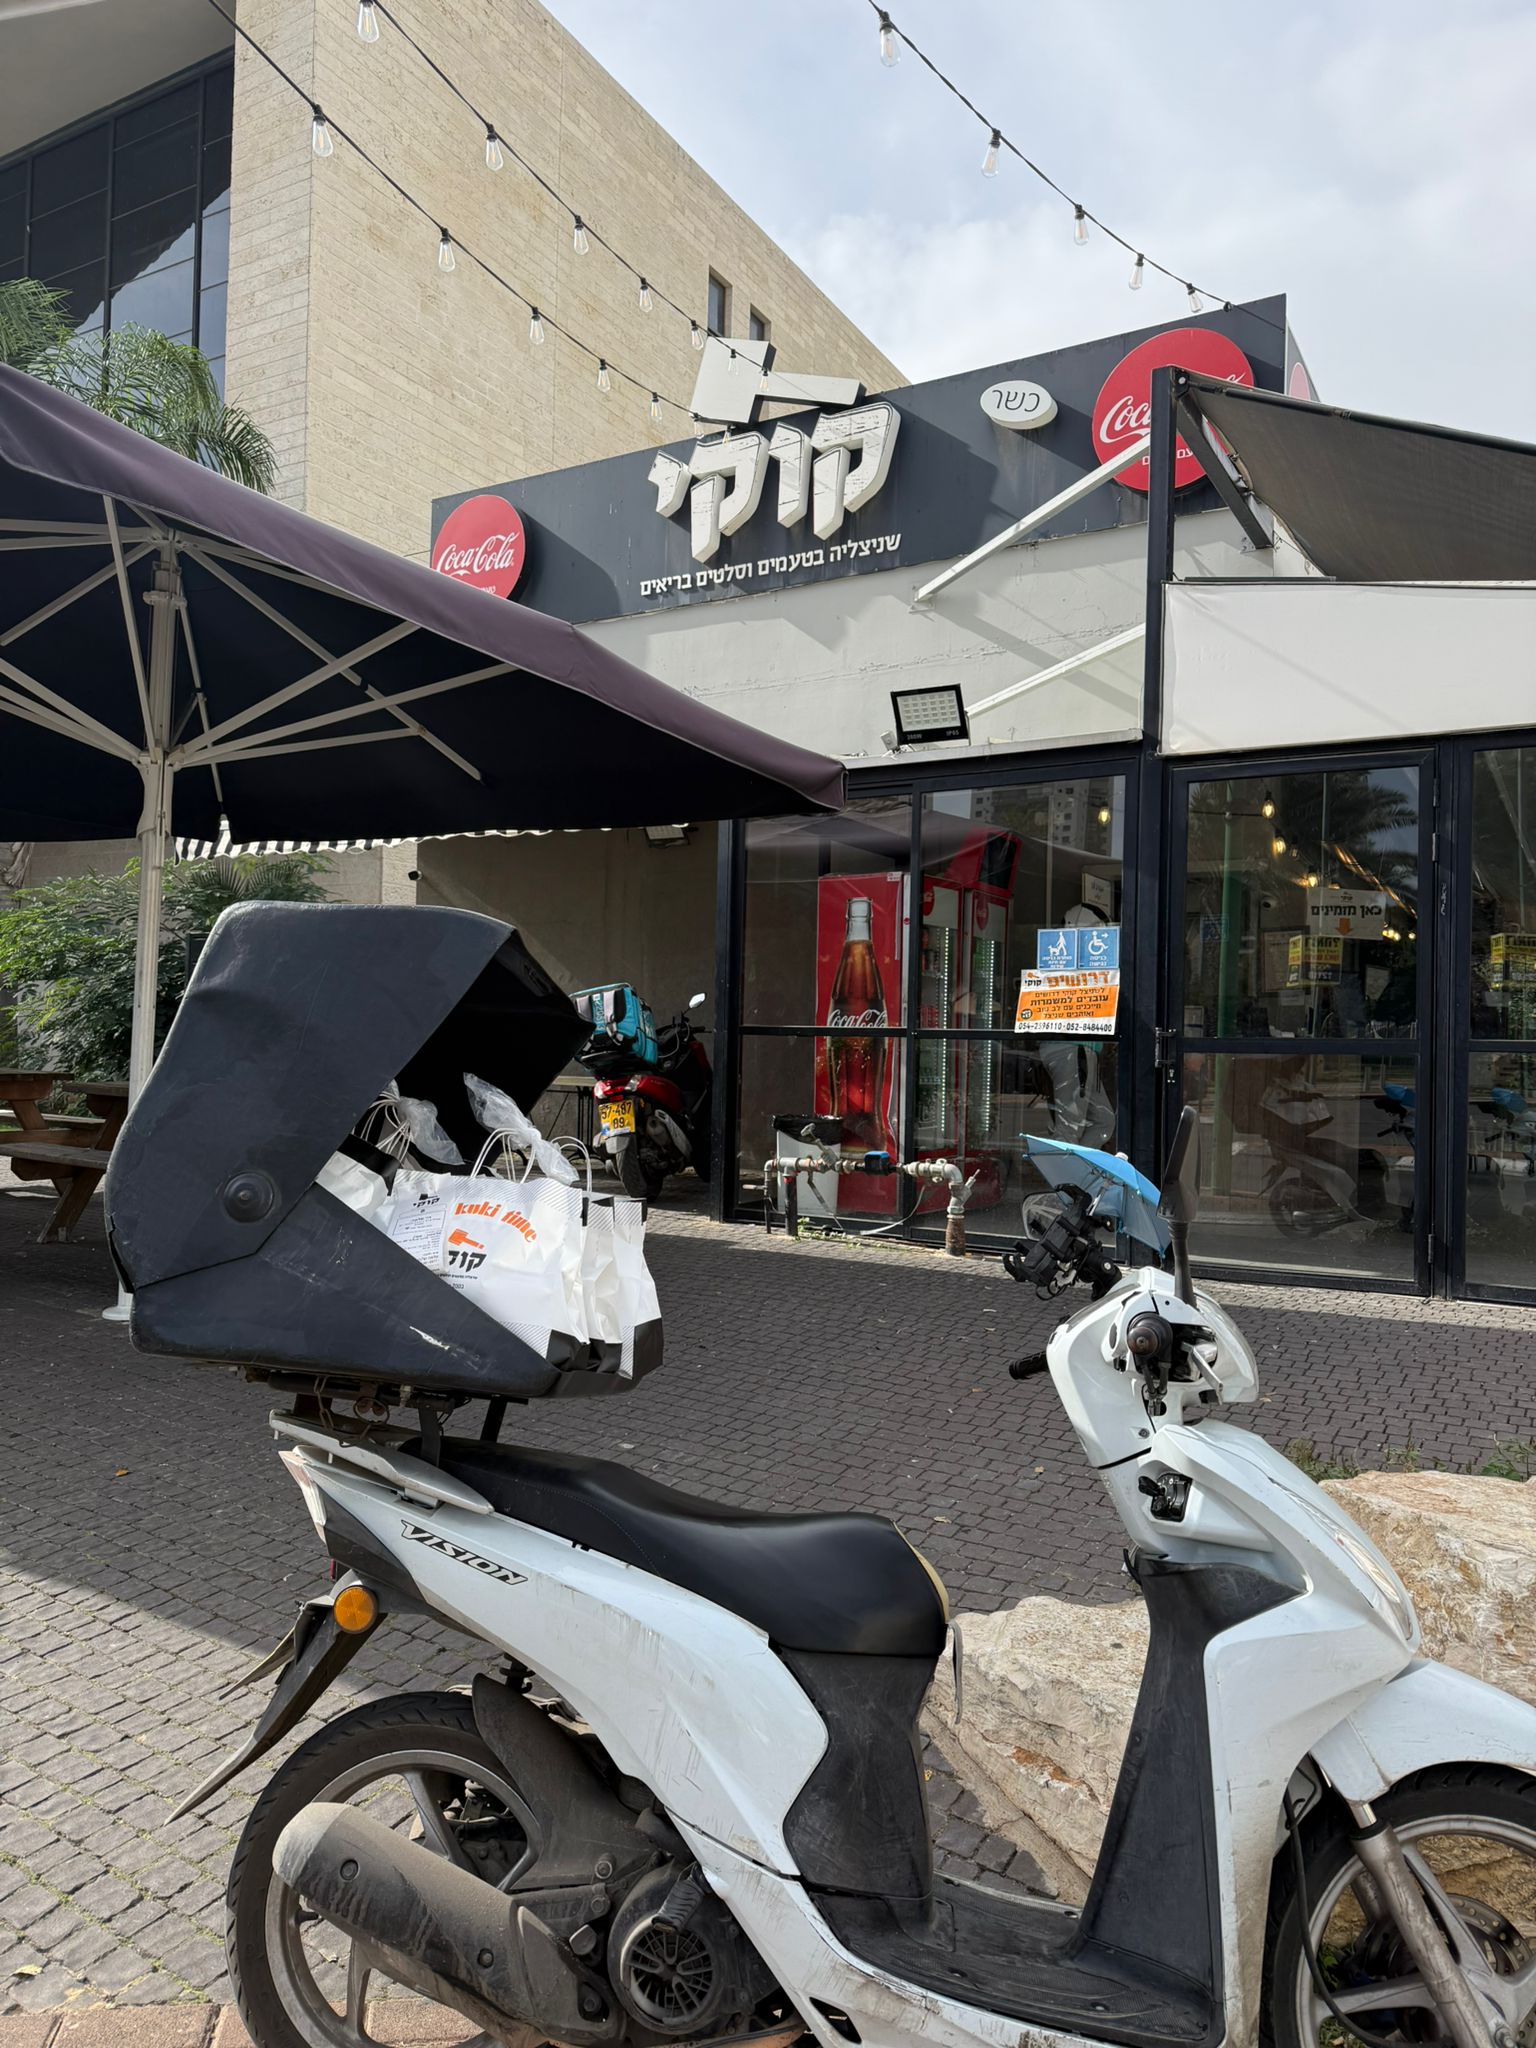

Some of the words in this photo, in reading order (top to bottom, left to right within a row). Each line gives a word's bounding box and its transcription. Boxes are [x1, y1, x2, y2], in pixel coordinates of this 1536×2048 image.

[992, 389, 1040, 413] כשר
[647, 400, 901, 563] קוקי
[829, 533, 902, 563] שניצליה
[696, 561, 752, 587] וסלטים
[757, 548, 825, 577] בטעמים
[640, 573, 692, 597] בריאים
[1311, 904, 1357, 916] מזמינים
[1360, 905, 1383, 918] כאן
[1024, 979, 1042, 988] קוקי
[1030, 996, 1073, 1007] למשמרות
[1052, 1004, 1060, 1012] לב
[1076, 994, 1109, 1003] עובדים
[613, 1117, 625, 1129] 89
[454, 1201, 502, 1217] kuki
[501, 1210, 537, 1243] time
[400, 1519, 529, 1586] VISION
